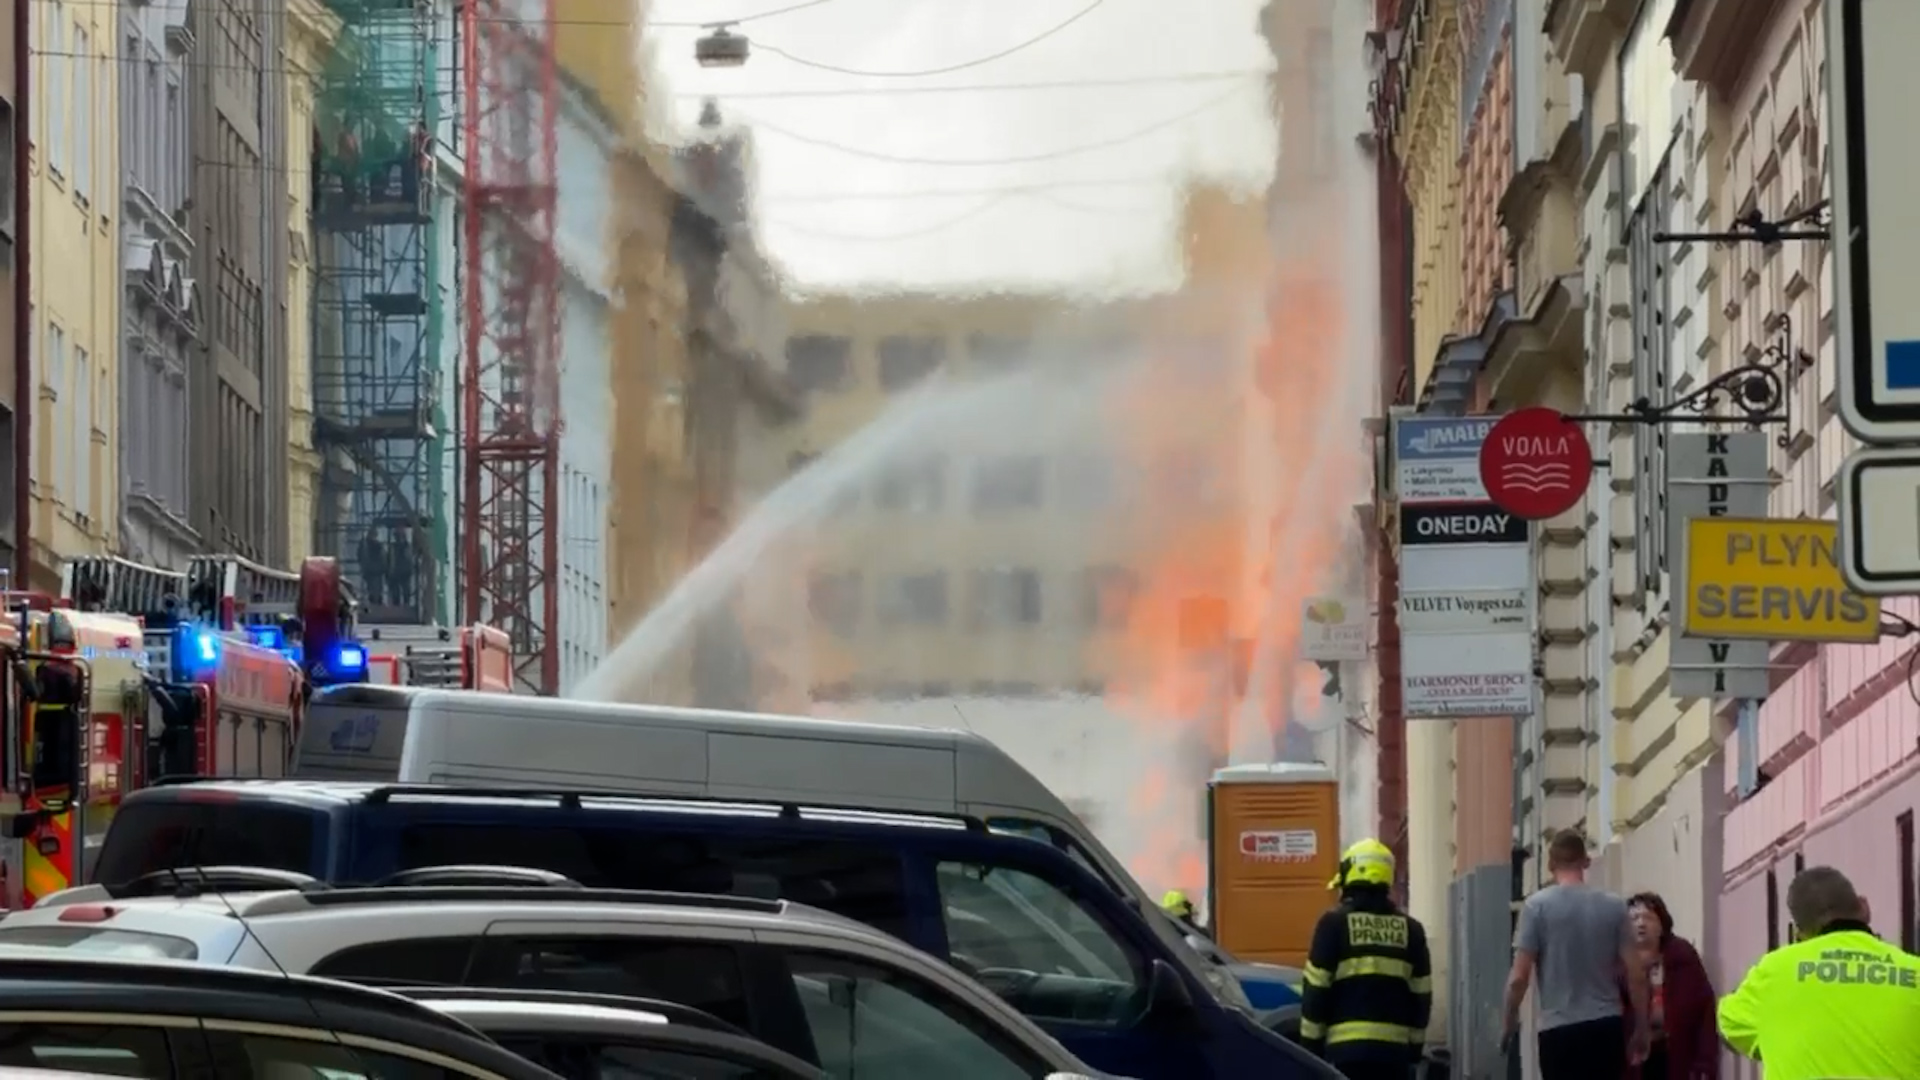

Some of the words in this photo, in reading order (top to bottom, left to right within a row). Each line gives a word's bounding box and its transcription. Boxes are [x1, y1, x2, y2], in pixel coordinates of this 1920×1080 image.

[1432, 421, 1496, 444] MALB
[1502, 436, 1570, 456] VOALA
[1416, 514, 1510, 535] ONEDAY
[1726, 532, 1839, 567] PLYN
[1403, 596, 1453, 611] VELVET
[1697, 583, 1869, 622] SERVIS
[1353, 929, 1405, 945] PRAHA
[1798, 961, 1917, 988] POLICIE
